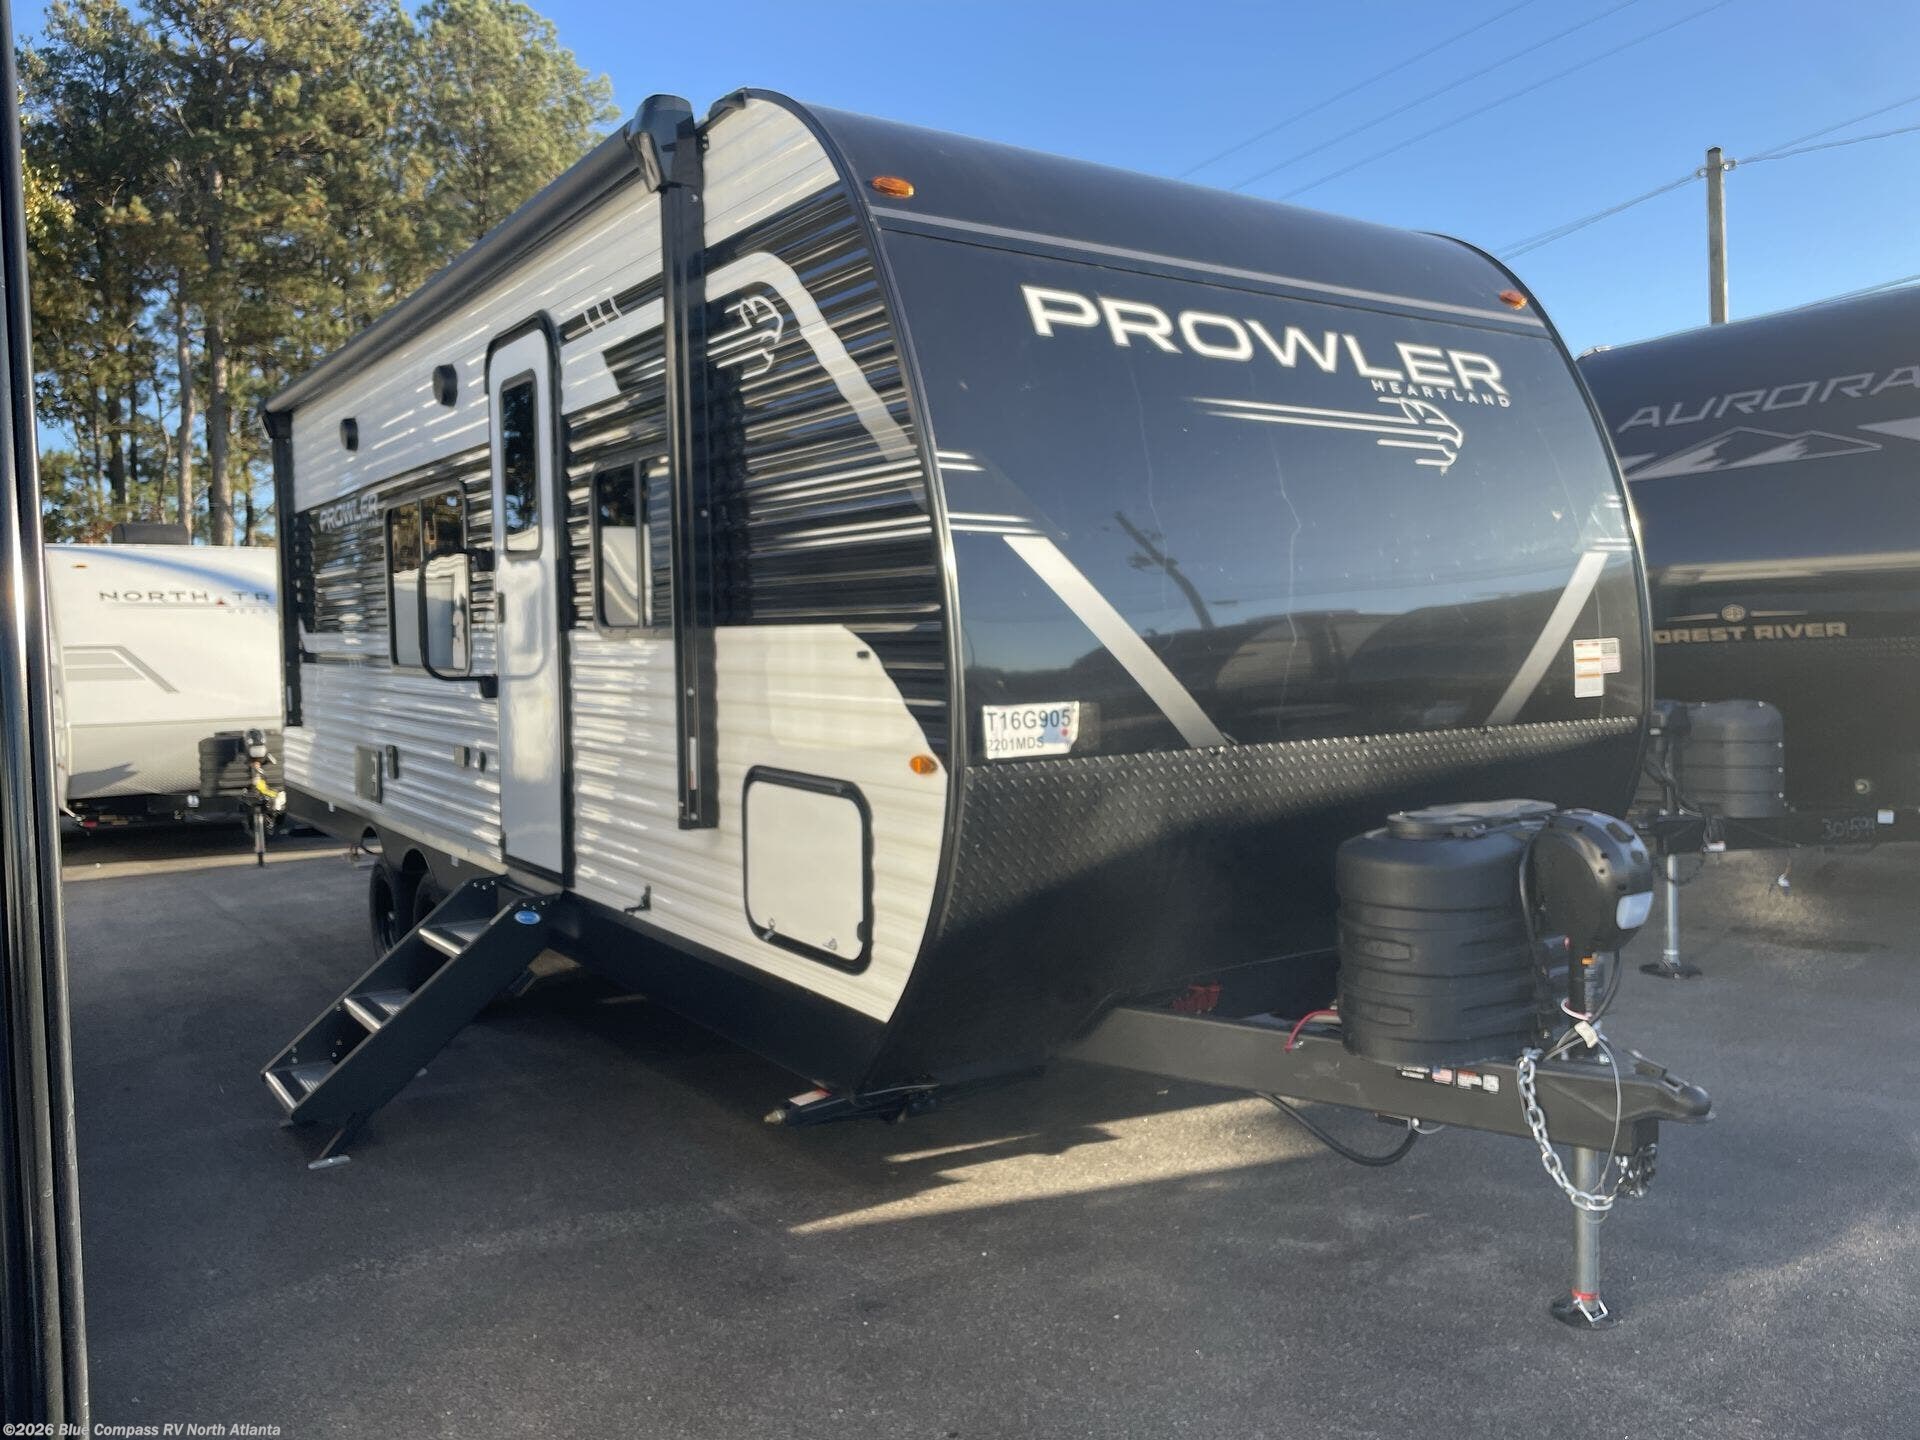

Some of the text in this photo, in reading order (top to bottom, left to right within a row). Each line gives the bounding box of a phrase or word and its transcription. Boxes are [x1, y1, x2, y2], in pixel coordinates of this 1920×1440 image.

[1020, 285, 1512, 394] PROWLER
[1371, 378, 1511, 408] HEARTLAND
[1617, 364, 1920, 434] AURORA
[318, 494, 379, 533] PROWLER
[98, 590, 271, 602] NORTH TR
[1653, 622, 1848, 644] OREST RIVER
[987, 709, 1071, 731] T16G905
